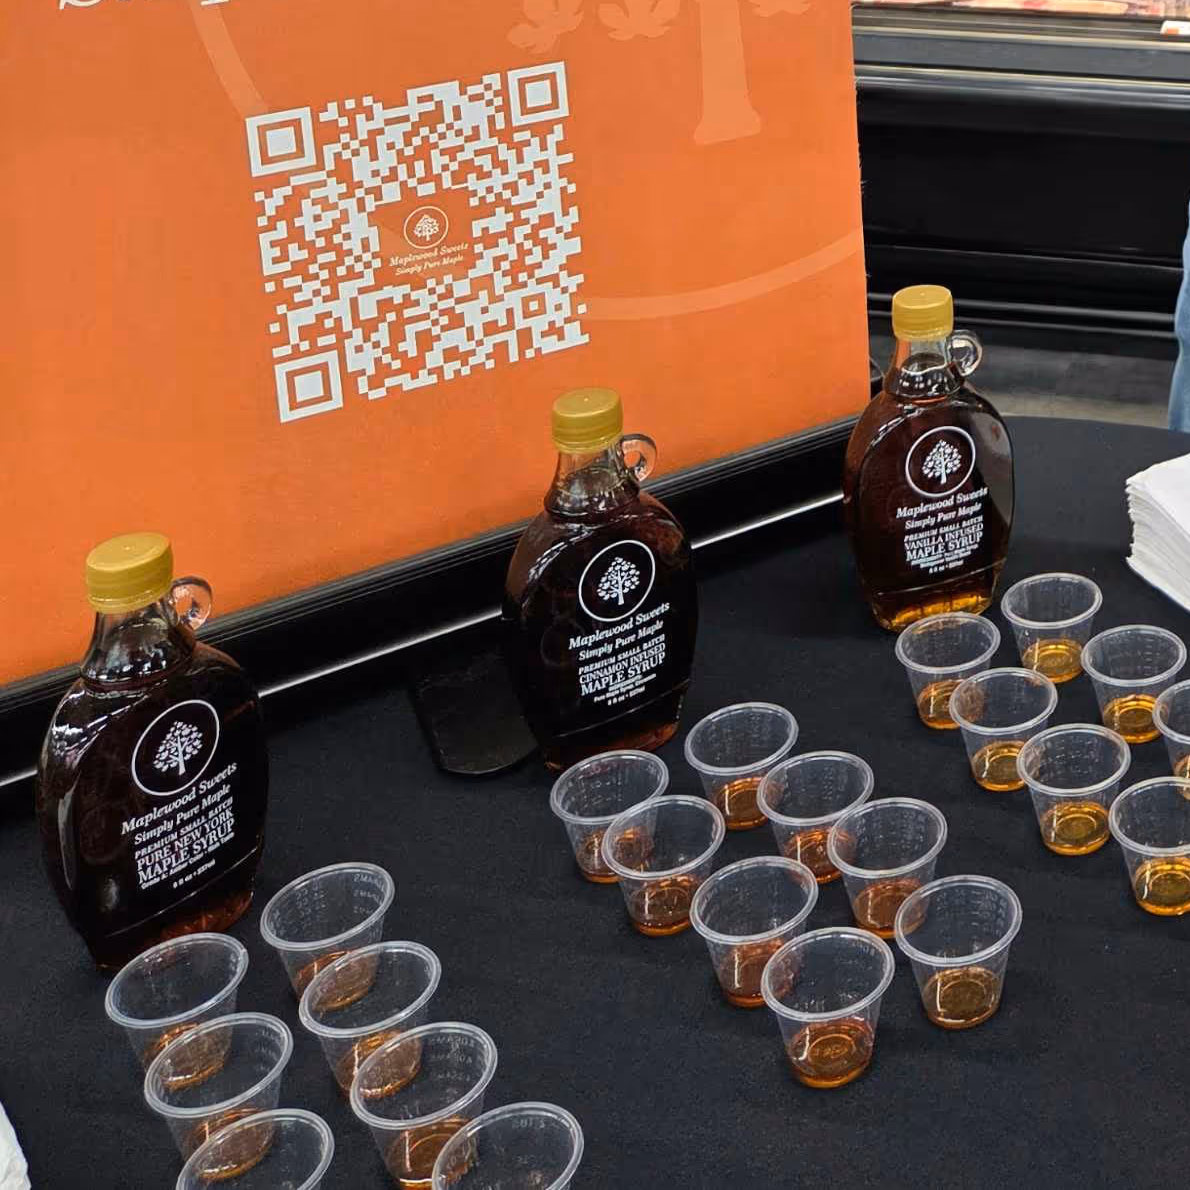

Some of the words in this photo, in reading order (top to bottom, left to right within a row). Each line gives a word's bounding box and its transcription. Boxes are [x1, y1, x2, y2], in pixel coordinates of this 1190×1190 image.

[896, 495, 954, 519] Maplewood
[956, 487, 988, 503] Sweets
[905, 514, 936, 530] Simply
[937, 510, 957, 522] Pure
[958, 502, 982, 519] Maple
[904, 528, 938, 542] PREMIUM
[939, 523, 960, 534] SMALL
[961, 515, 983, 527] BATCH
[904, 535, 944, 551] VANILLA
[945, 522, 984, 540] INFUSED
[906, 541, 945, 562] MAPLE
[948, 531, 983, 551] SYRUP
[568, 618, 634, 650] Maplewood
[635, 602, 670, 626] Sweets
[578, 643, 613, 661] Simply
[615, 634, 636, 649] Pure
[637, 620, 664, 644] Maple
[578, 657, 616, 675] PREMIUM
[617, 648, 641, 661] SMALL
[642, 634, 665, 650] BATCH
[579, 663, 629, 684] CINNAMON
[629, 643, 666, 667] INFUSED
[581, 671, 625, 696] MAPLE
[628, 652, 666, 678] SYRUP
[121, 787, 196, 836] Maplewood
[199, 762, 237, 794] Sweets
[134, 816, 174, 846] Simply
[176, 805, 200, 825] Pure
[201, 783, 231, 813] Maple
[135, 831, 177, 859] PREMIUM
[180, 816, 207, 836] SMALL
[208, 797, 233, 819] BATCH
[137, 844, 172, 871] PURE
[174, 827, 203, 853] NEW
[204, 808, 234, 833] YORK
[138, 848, 190, 884] MAPLE
[193, 818, 235, 854] SYRUP
